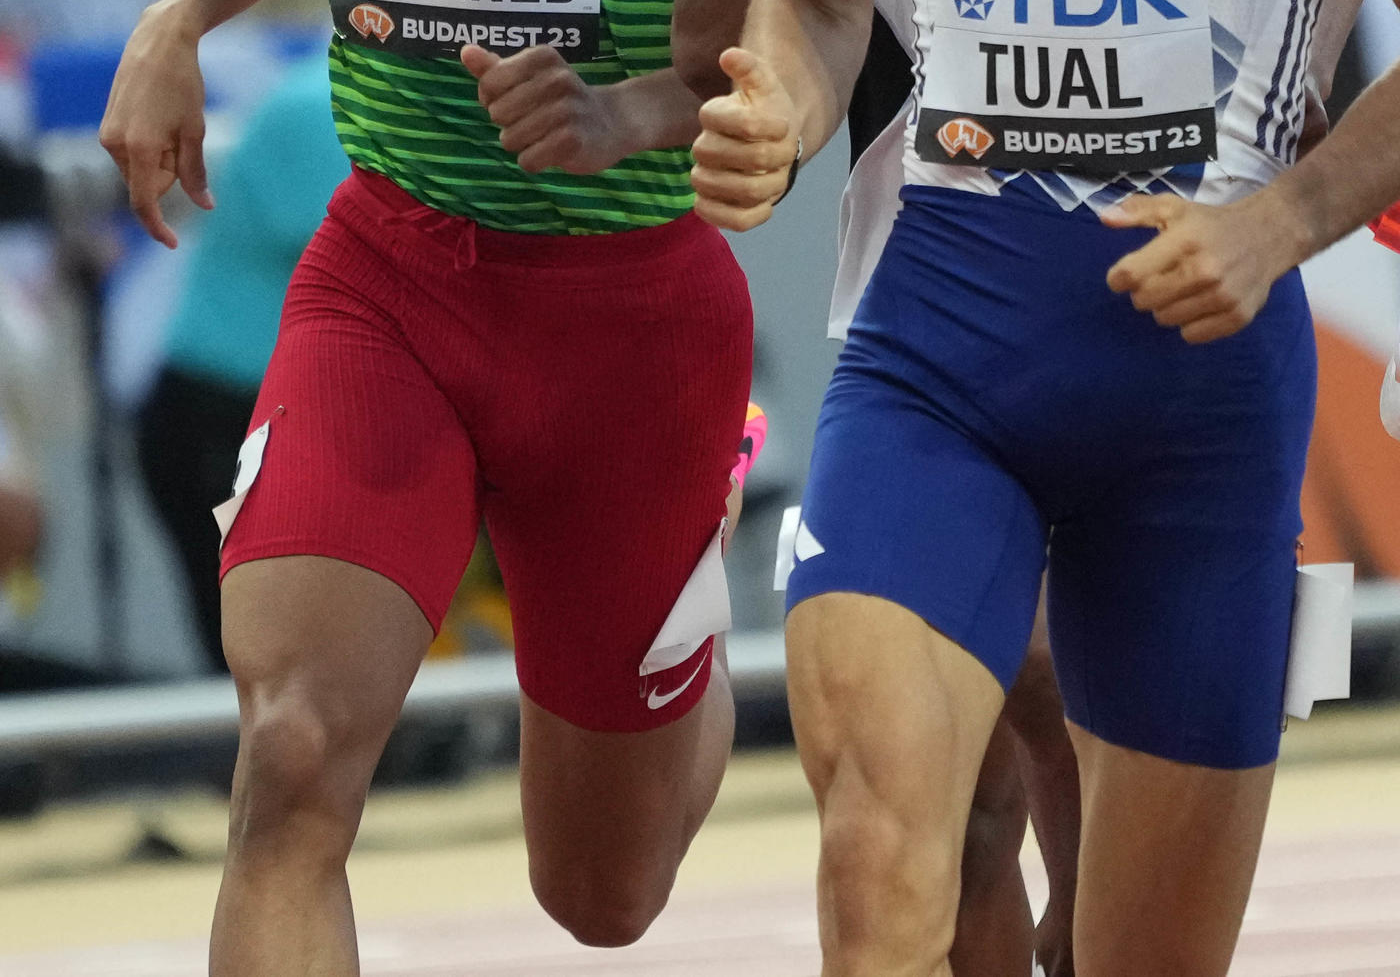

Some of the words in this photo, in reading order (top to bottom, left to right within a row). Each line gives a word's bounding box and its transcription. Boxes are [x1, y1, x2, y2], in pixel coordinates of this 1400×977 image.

[402, 18, 543, 48] BUDAPEST
[547, 27, 581, 48] 23
[979, 42, 1143, 109] TUAL
[1004, 130, 1162, 155] BUDAPEST
[1167, 124, 1202, 149] 23
